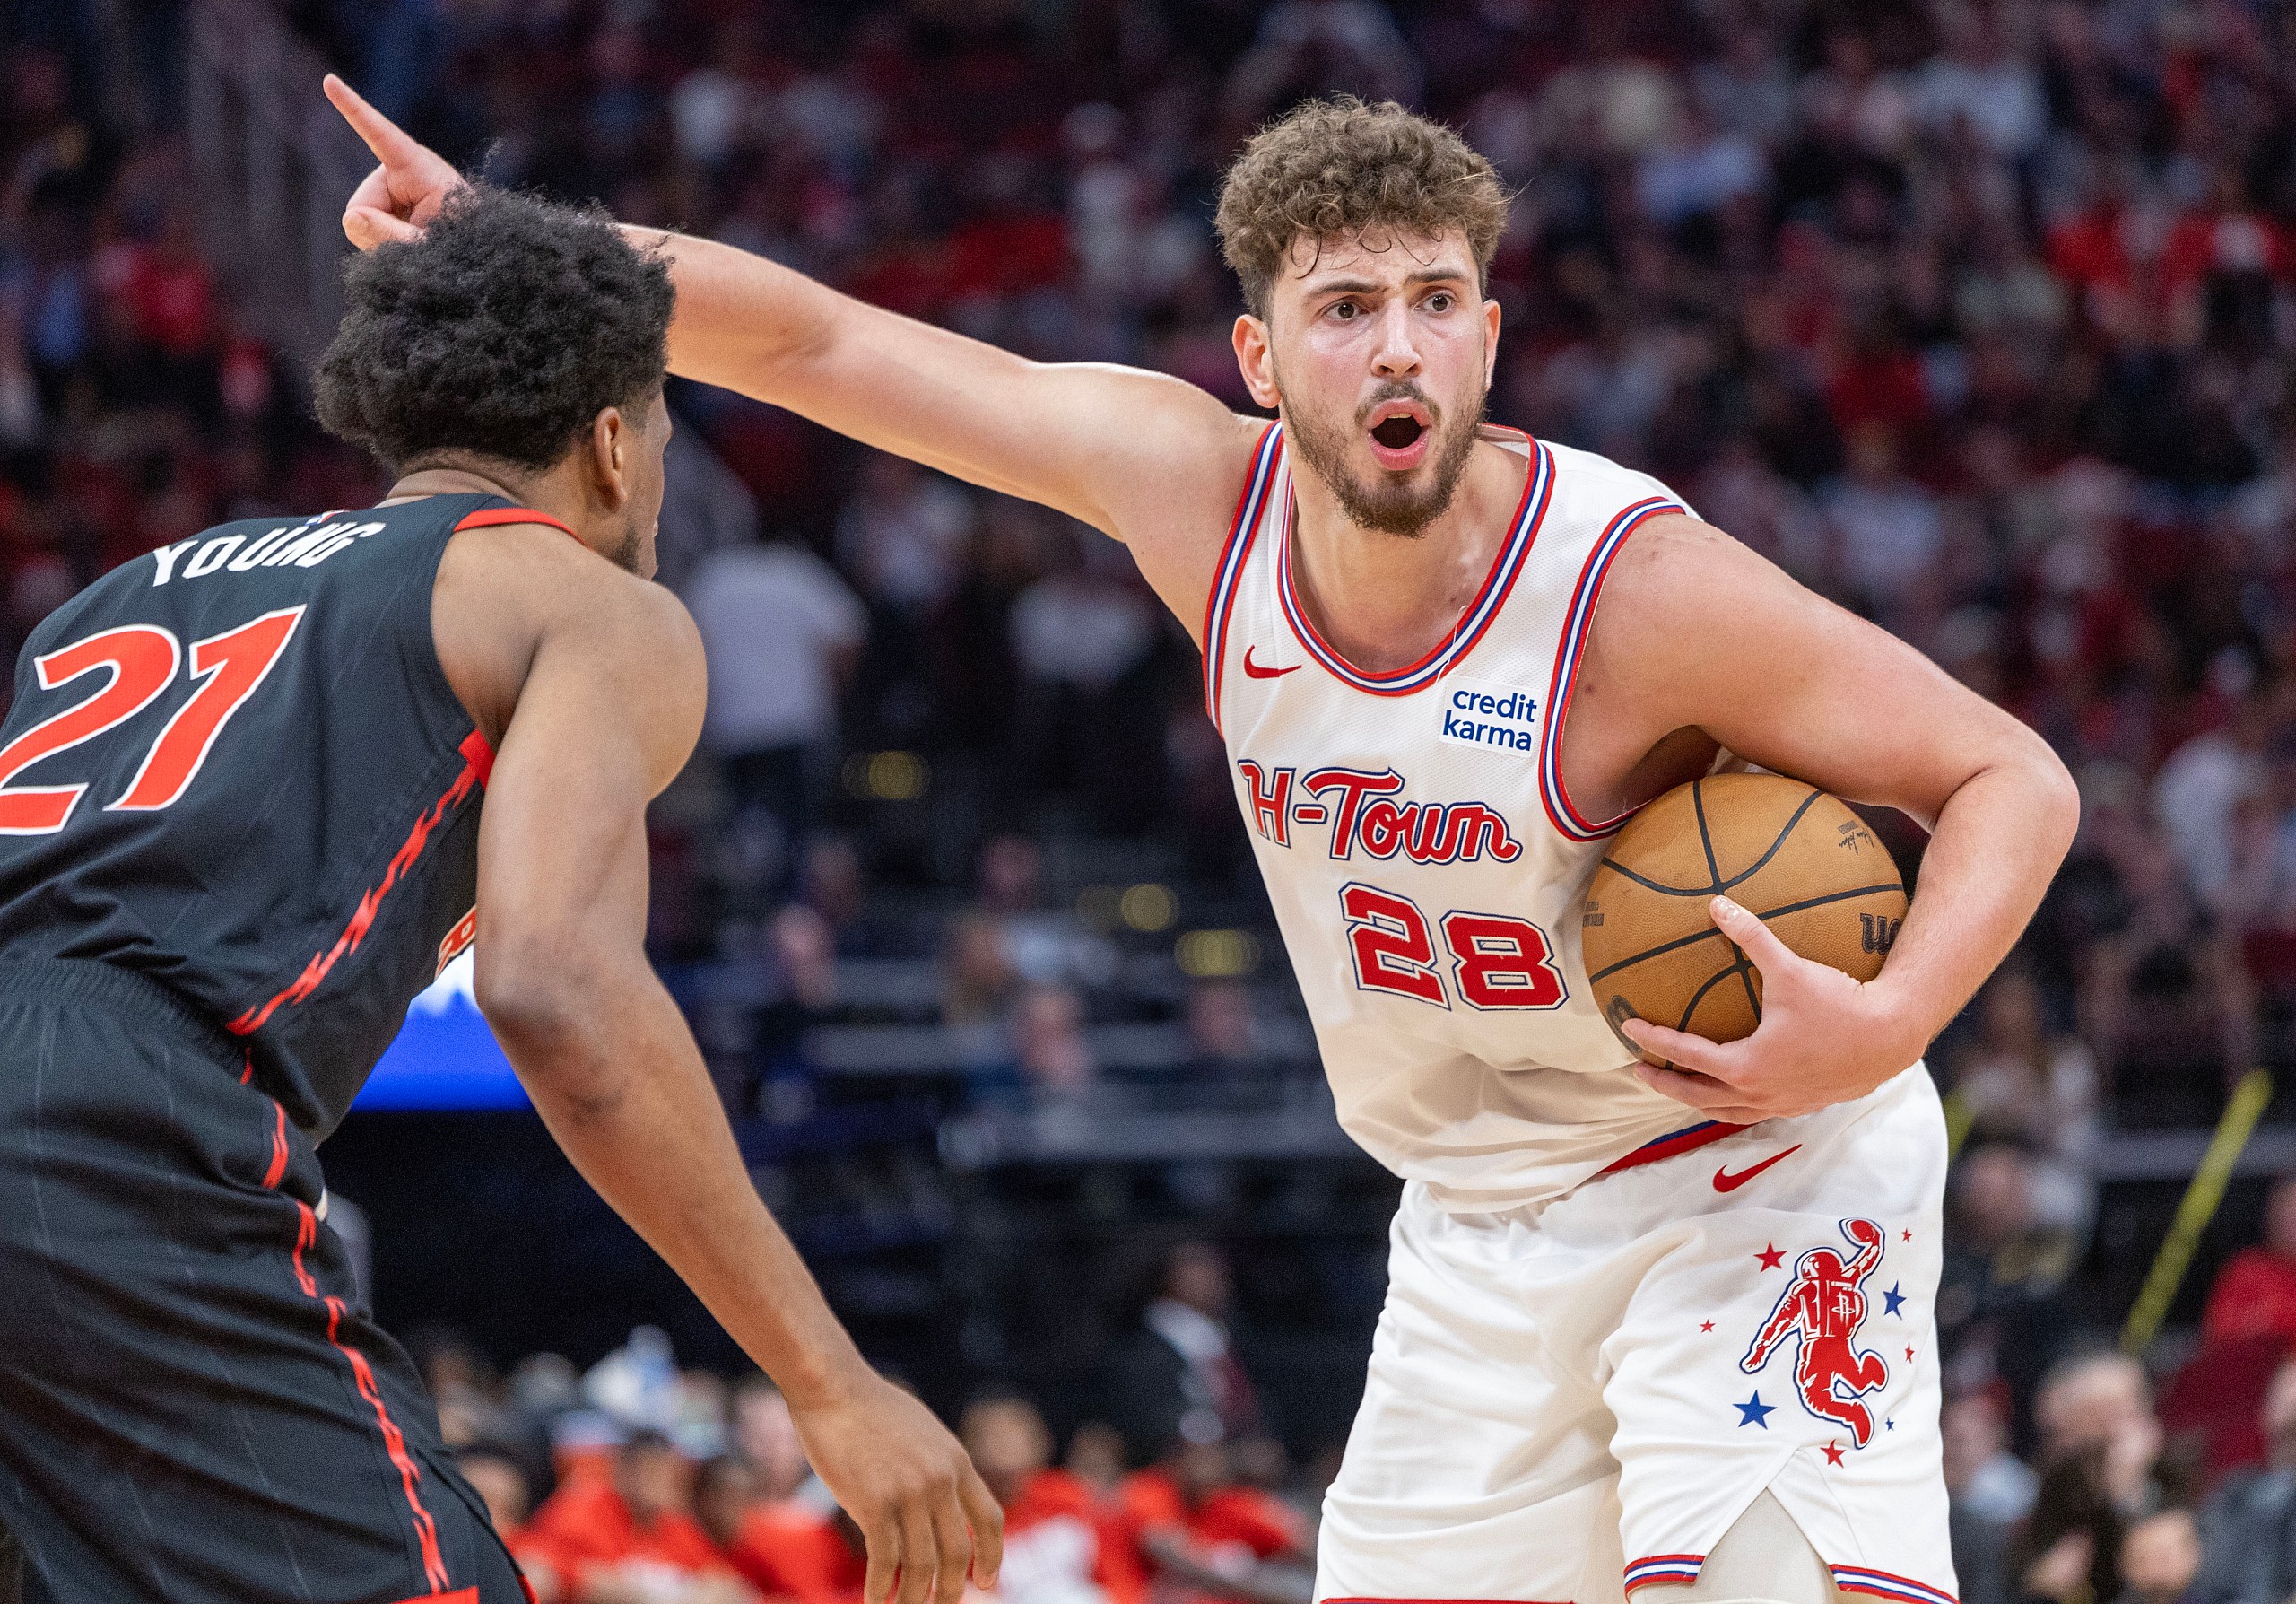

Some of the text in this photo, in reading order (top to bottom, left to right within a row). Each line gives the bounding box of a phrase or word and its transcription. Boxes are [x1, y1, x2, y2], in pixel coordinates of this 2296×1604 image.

[152, 521, 387, 588] YOUNG
[0, 603, 308, 836] 21
[1441, 709, 1533, 752] karma
[1451, 688, 1538, 723] credit
[1237, 758, 1524, 866] H-Town
[1338, 881, 1570, 1012] 28
